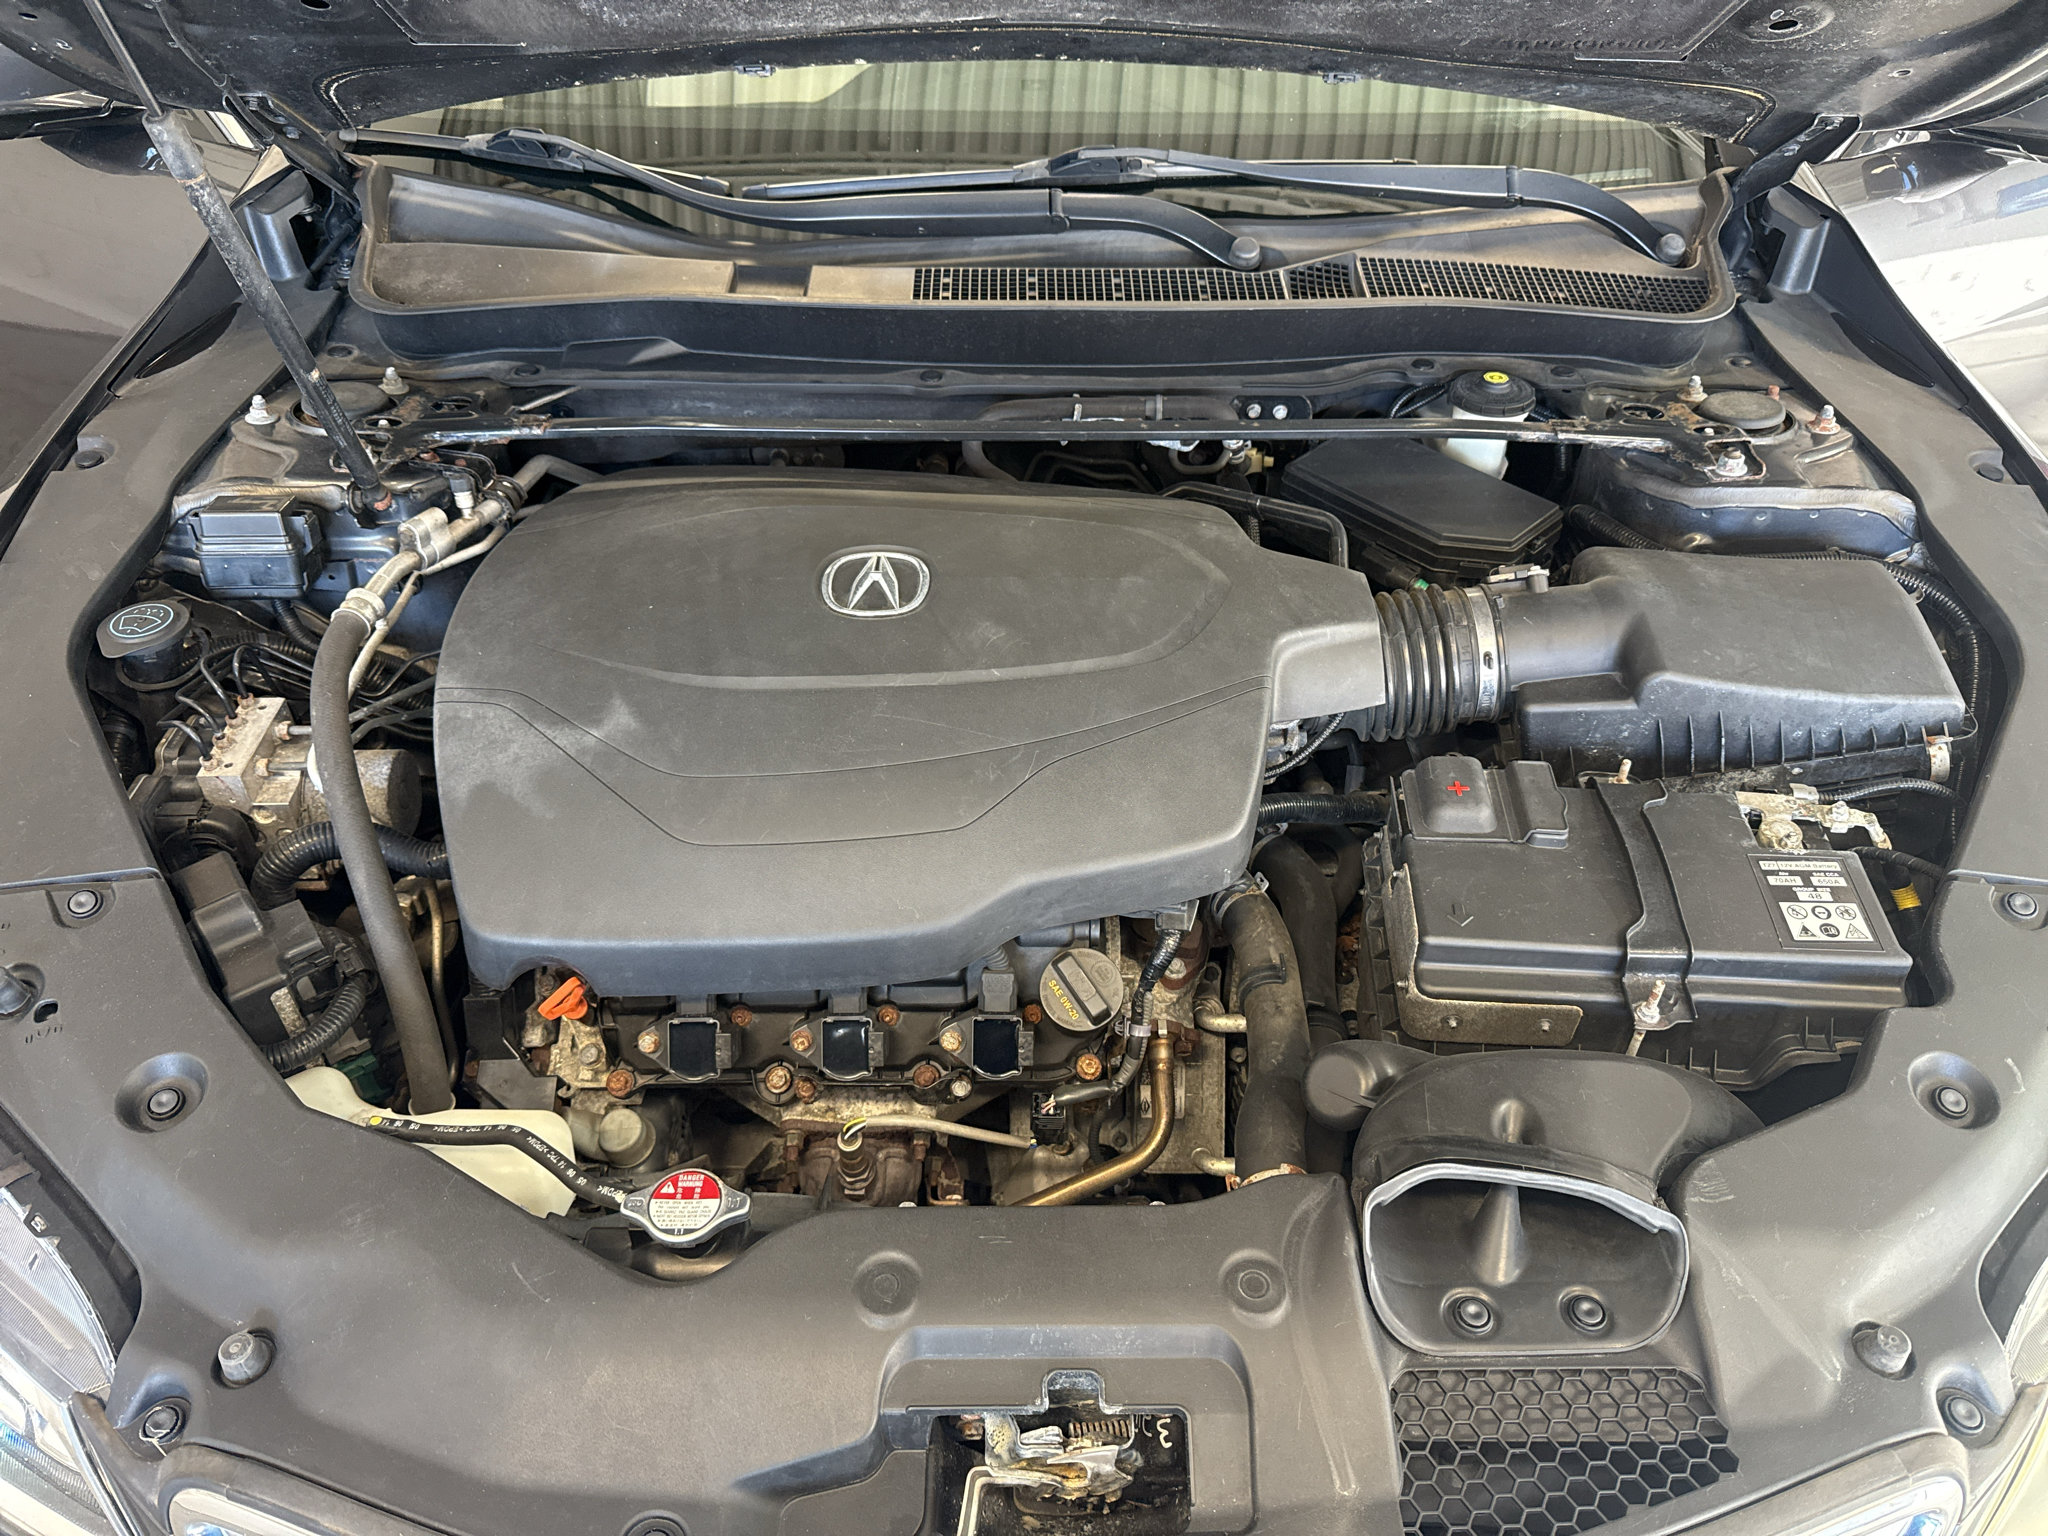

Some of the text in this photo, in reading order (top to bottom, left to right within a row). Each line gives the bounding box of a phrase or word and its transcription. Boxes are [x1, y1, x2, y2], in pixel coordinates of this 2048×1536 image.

[1048, 980, 1079, 1020] SAE 0W-20
[546, 1151, 561, 1164] TPC
